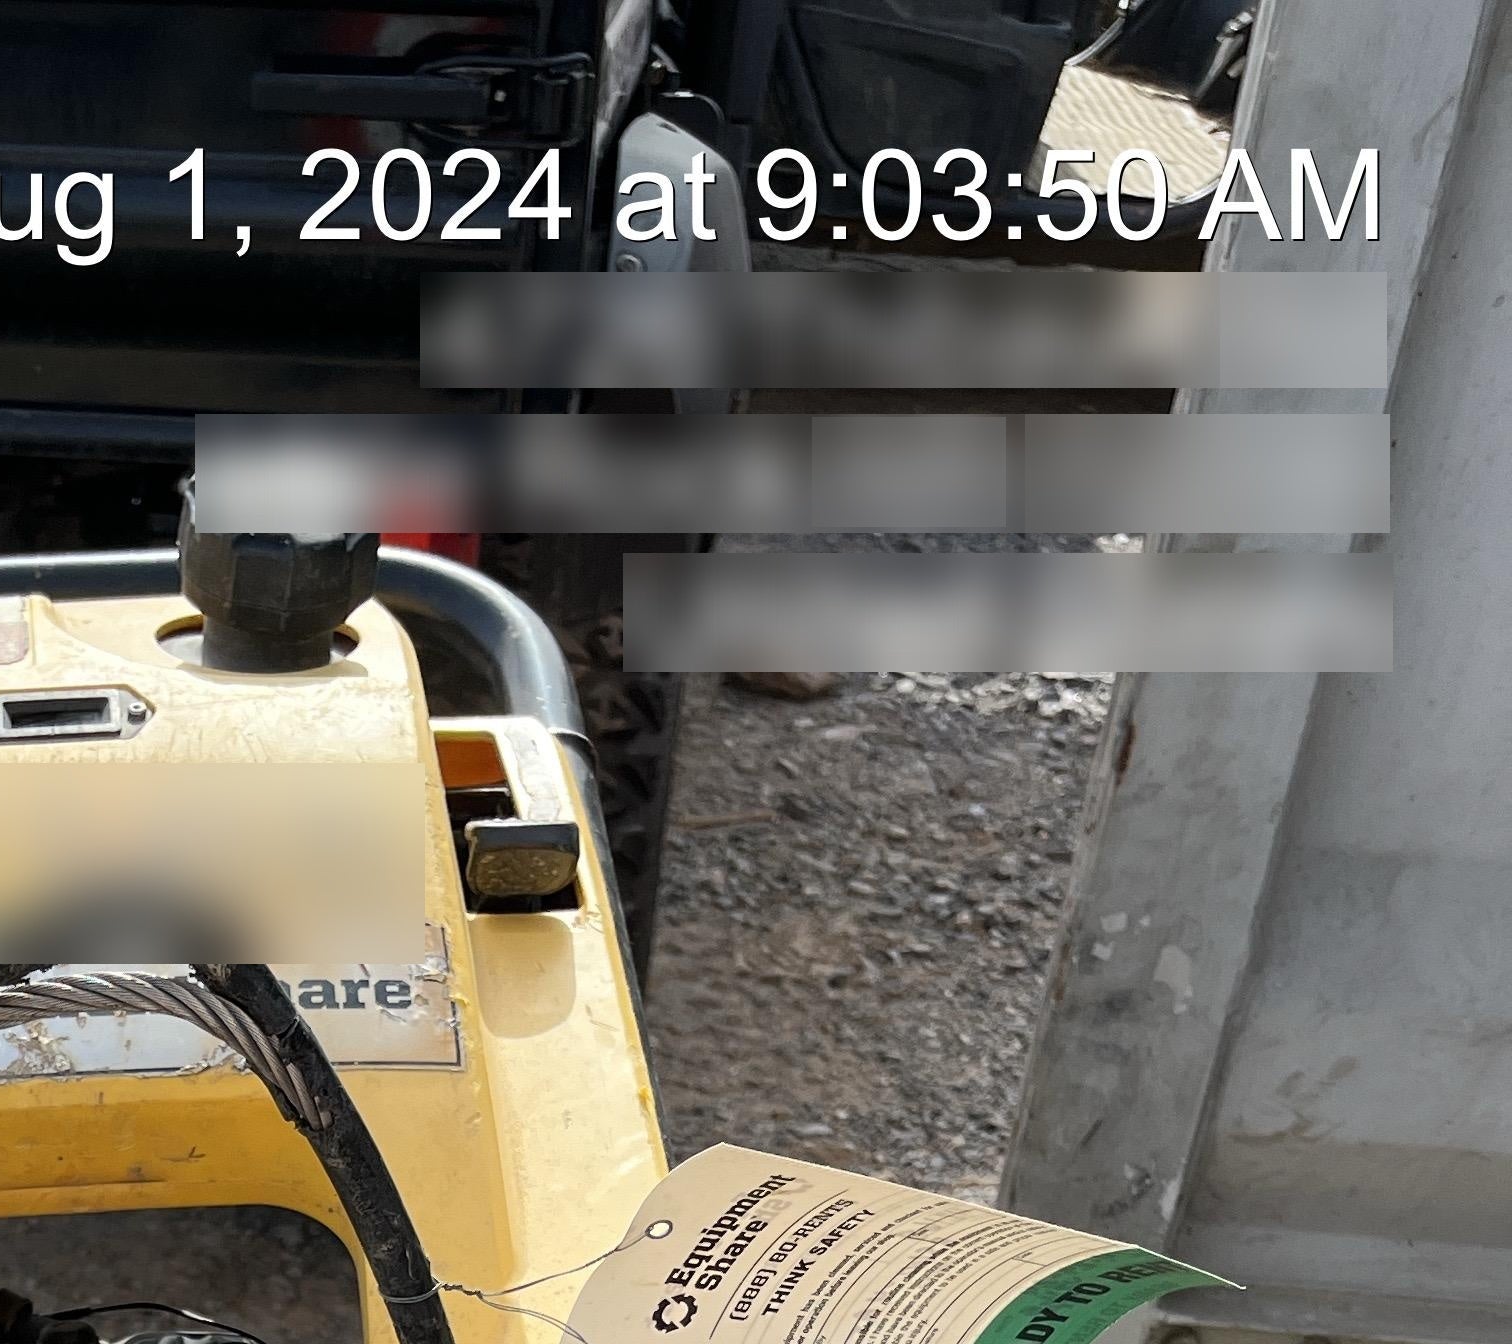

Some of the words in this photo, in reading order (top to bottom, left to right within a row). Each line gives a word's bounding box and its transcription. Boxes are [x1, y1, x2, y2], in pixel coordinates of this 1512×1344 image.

[665, 1175, 796, 1287] Equipment
[695, 1219, 768, 1291] Share
[761, 1259, 816, 1315] THINK
[809, 1209, 875, 1255] SAFETY
[1054, 1283, 1110, 1304] TO
